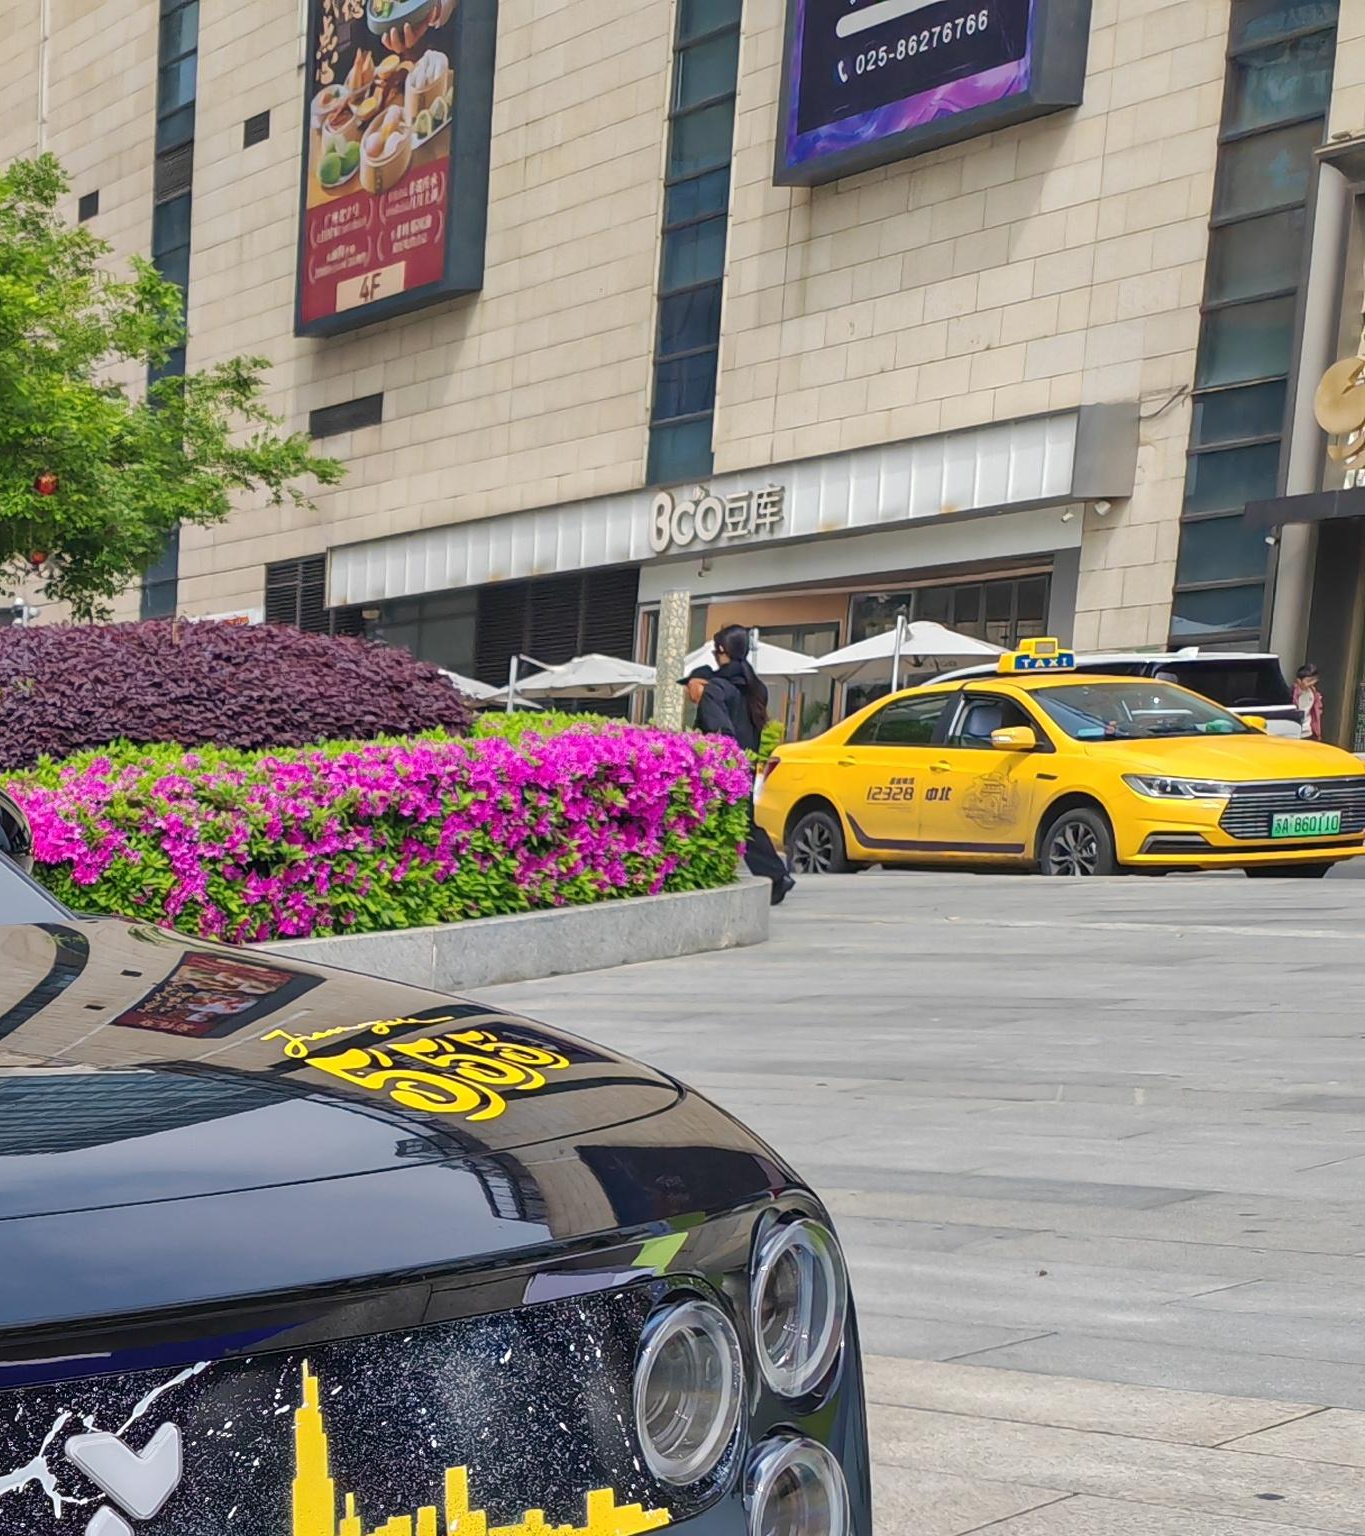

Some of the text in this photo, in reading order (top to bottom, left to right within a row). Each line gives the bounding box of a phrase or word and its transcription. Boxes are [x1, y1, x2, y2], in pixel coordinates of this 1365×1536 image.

[855, 9, 990, 76] 025-86276766
[358, 272, 382, 303] 4F
[1020, 657, 1068, 668] TAXI
[866, 786, 915, 801] 12328
